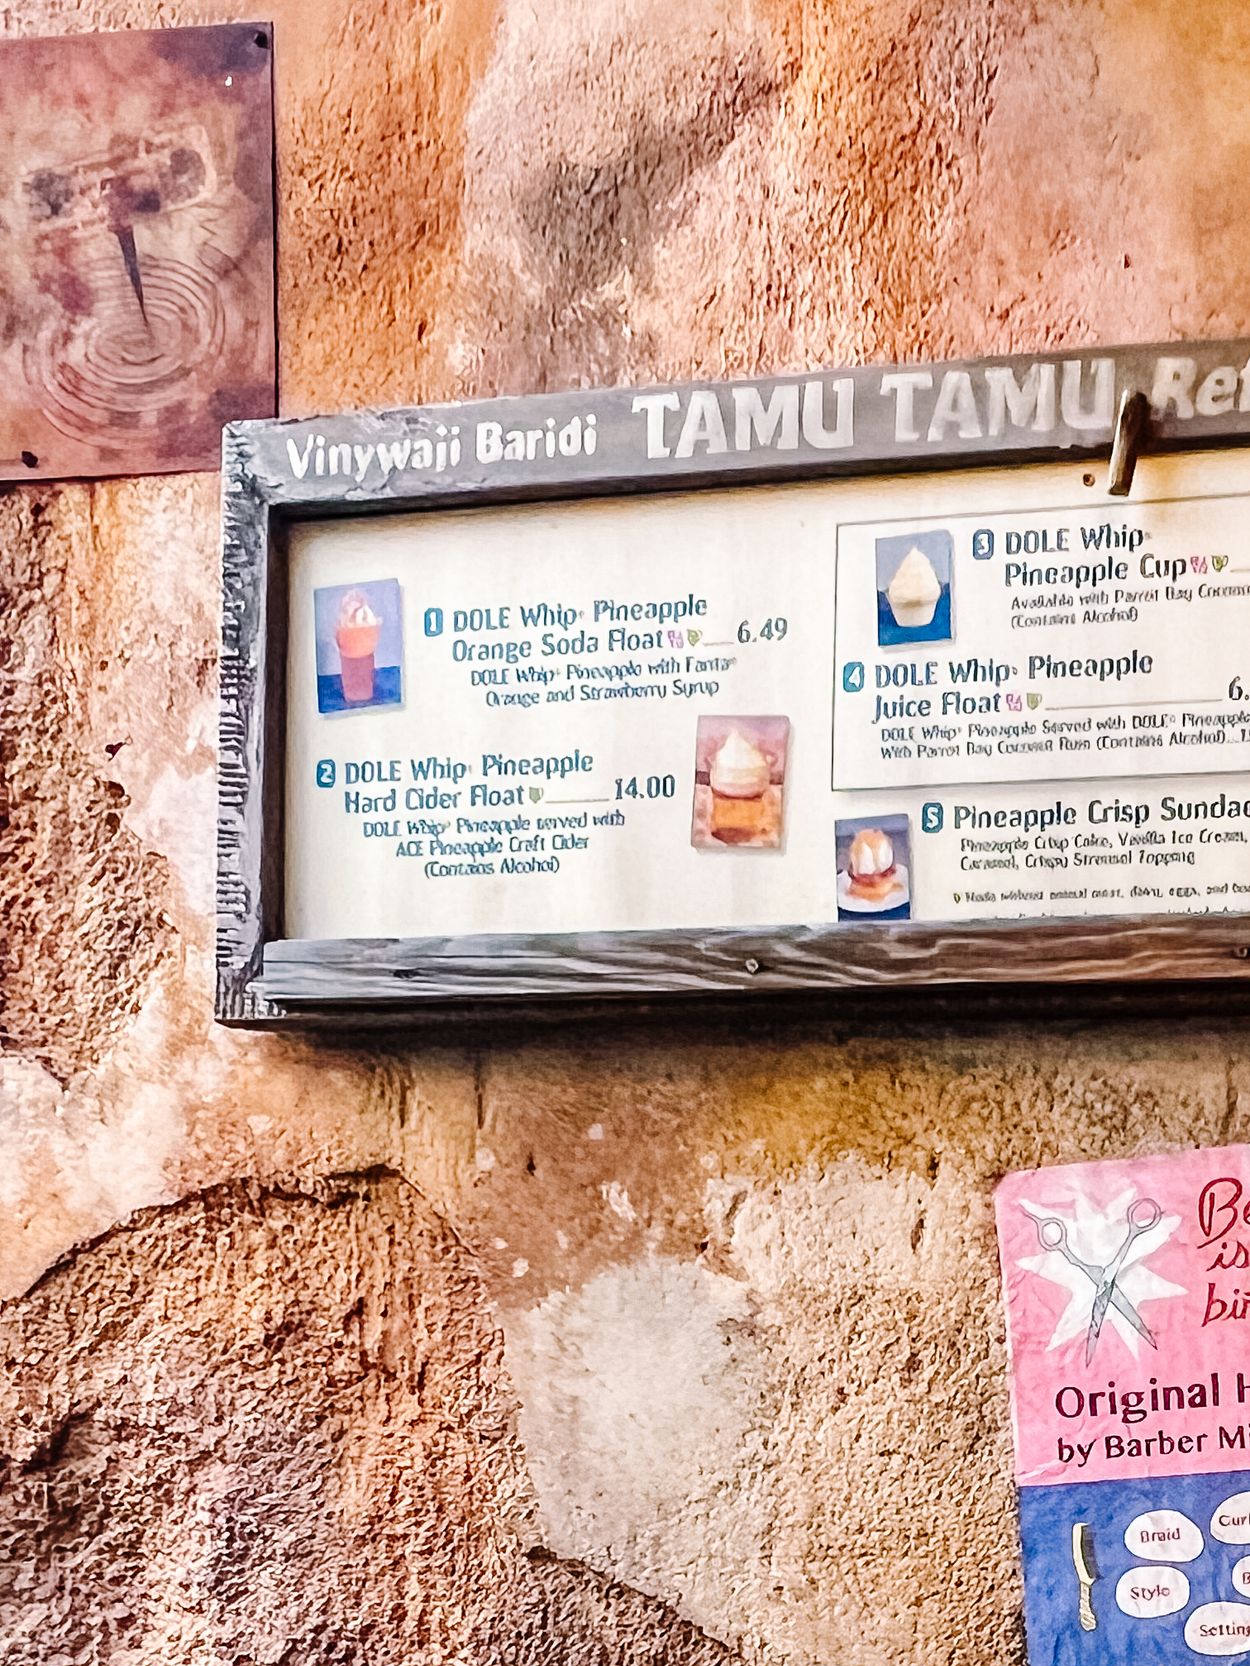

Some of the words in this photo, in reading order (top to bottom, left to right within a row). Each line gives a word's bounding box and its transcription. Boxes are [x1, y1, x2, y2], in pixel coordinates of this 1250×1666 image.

[286, 424, 461, 482] Vinywaji
[476, 413, 597, 464] Baridi
[632, 377, 855, 459] TAMU
[880, 357, 1115, 443] TAMU
[1005, 529, 1069, 555] DOLE
[1005, 560, 1128, 587] Pineapple
[1139, 553, 1187, 579] Cup
[452, 607, 510, 633] DOLE
[593, 594, 708, 624] Pineapple
[452, 638, 532, 665] Orange
[541, 629, 599, 655] Soda
[608, 630, 663, 651] Float
[737, 618, 789, 644] 6.49
[875, 661, 939, 689] DOLE
[1028, 650, 1154, 681] Pineapple
[871, 693, 931, 723] Juice
[942, 690, 1001, 716] Float
[344, 760, 401, 784] DOLE
[482, 750, 593, 781] Pineapple
[344, 788, 397, 814] Hard
[405, 786, 461, 810] Cider
[470, 784, 524, 808] Float
[614, 774, 675, 800] 14.00
[954, 802, 1076, 832] Pineapple
[1088, 798, 1149, 826] Crisp
[1206, 1243, 1249, 1274] is
[1054, 1372, 1220, 1425] Original
[1056, 1438, 1094, 1467] by
[1104, 1431, 1209, 1461] Barber
[1139, 1527, 1181, 1545] Braid
[1130, 1583, 1171, 1601] Style
